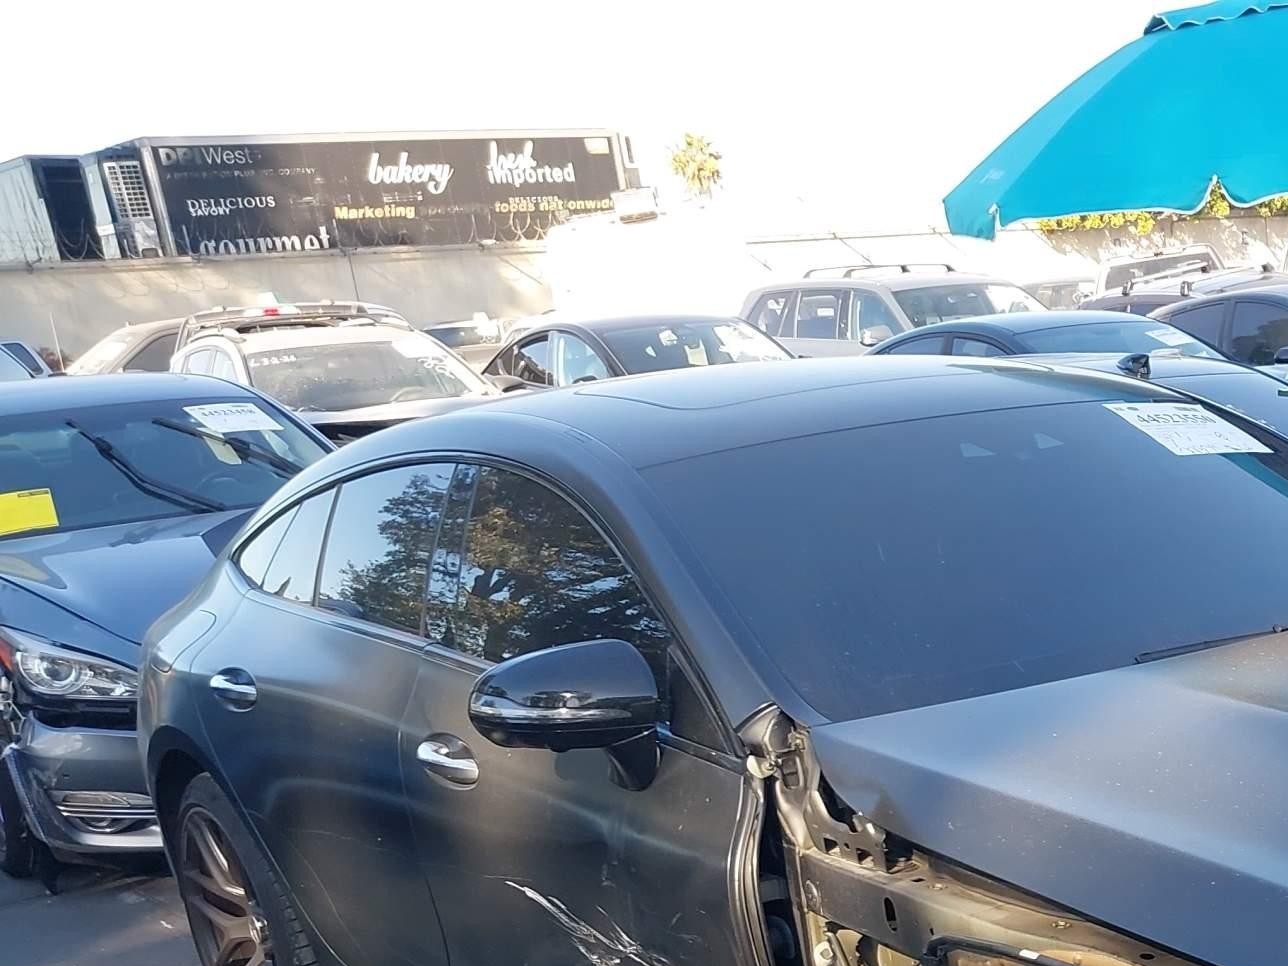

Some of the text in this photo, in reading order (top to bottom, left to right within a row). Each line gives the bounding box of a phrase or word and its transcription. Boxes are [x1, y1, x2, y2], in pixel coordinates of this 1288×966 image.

[201, 147, 254, 166] West
[367, 151, 455, 195] bakery
[487, 161, 576, 188] imported
[186, 196, 277, 210] DELICIOUS
[334, 204, 417, 220] Marketing
